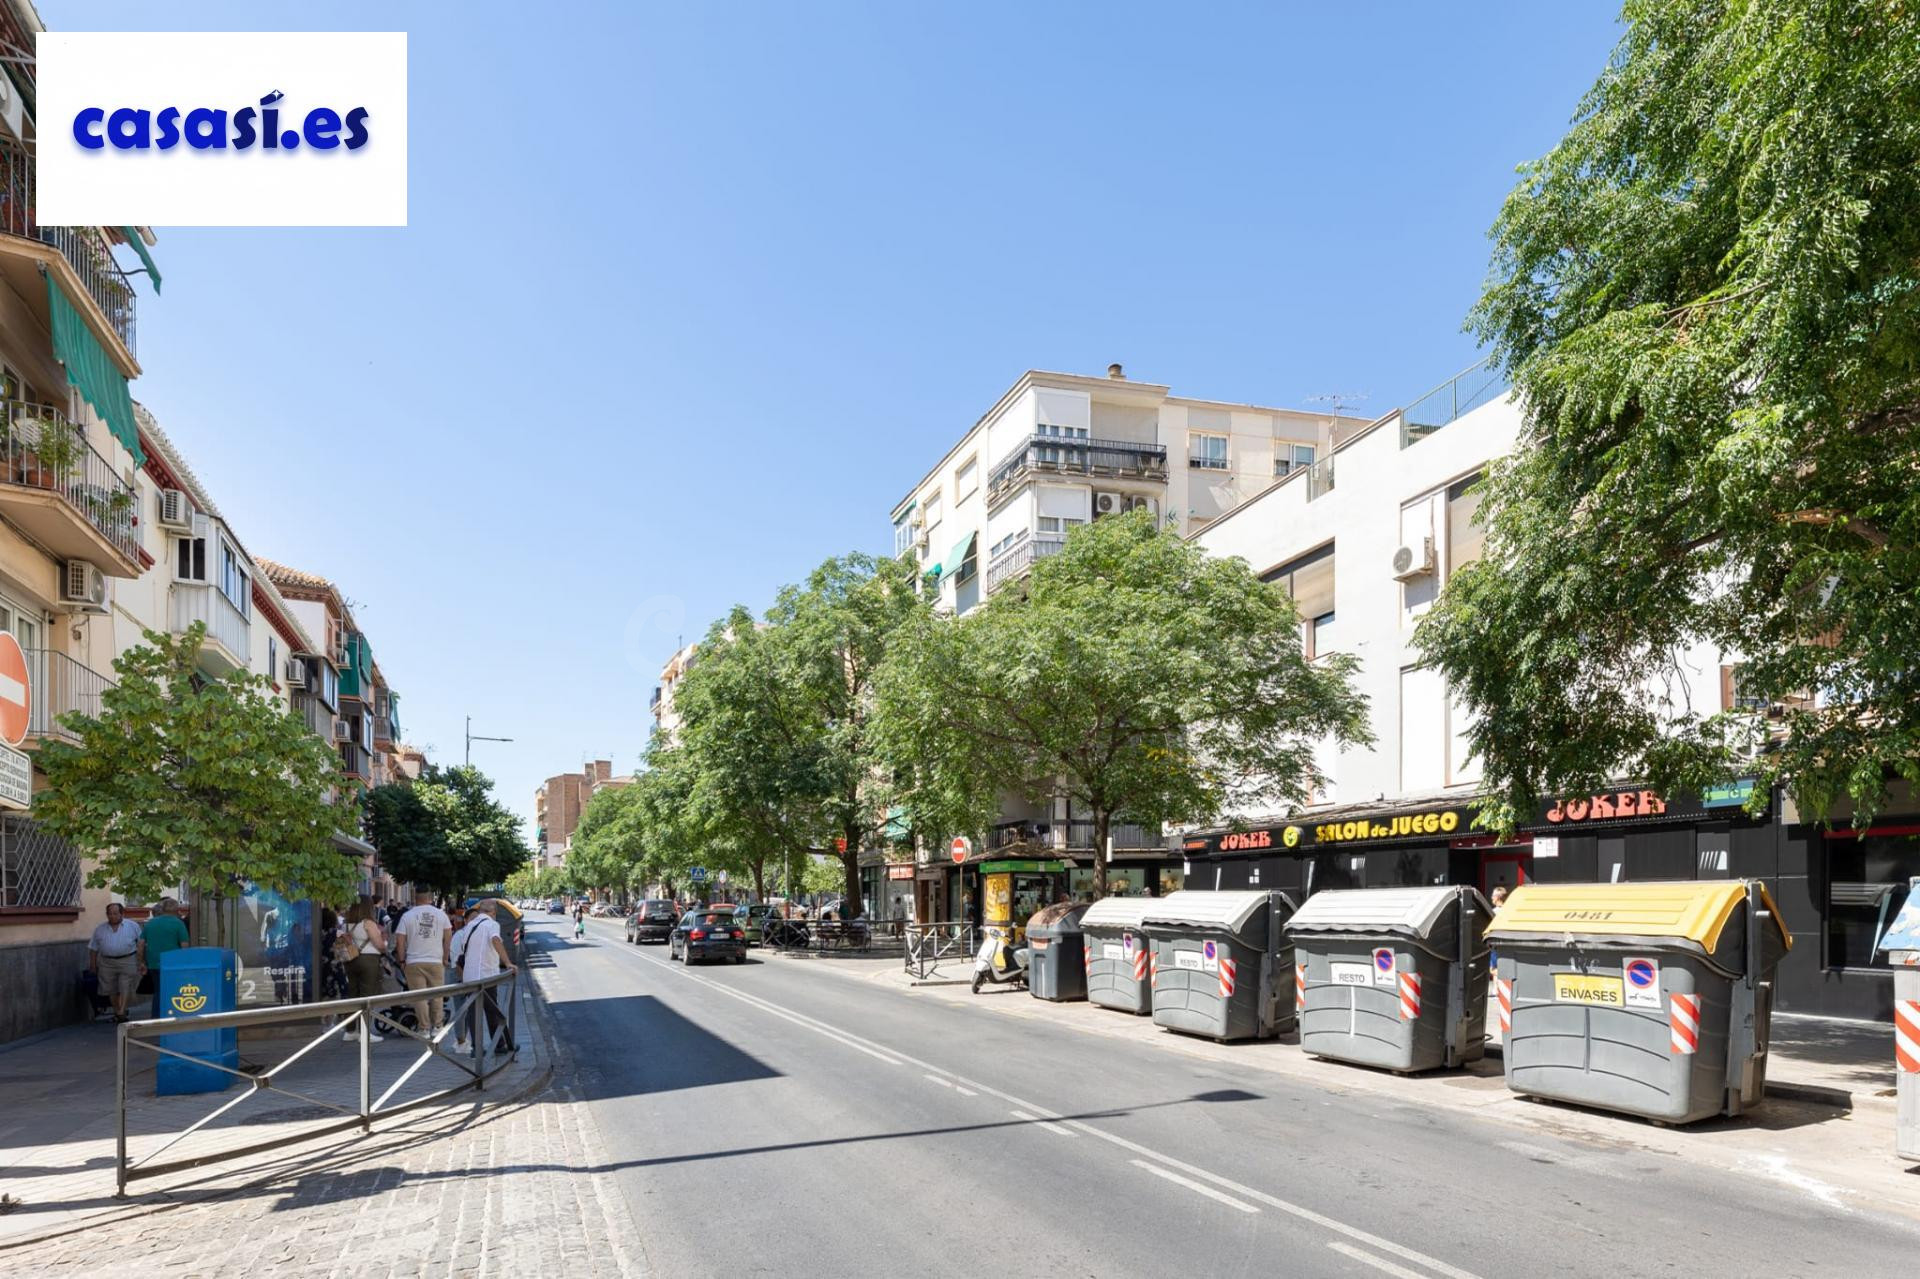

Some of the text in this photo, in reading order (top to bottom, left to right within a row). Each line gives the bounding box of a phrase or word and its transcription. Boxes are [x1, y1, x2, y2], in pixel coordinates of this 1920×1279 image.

[1547, 790, 1666, 822] JOKER
[1370, 824, 1389, 838] de
[1389, 811, 1459, 836] JUEGO
[1220, 831, 1271, 850] JOKER
[263, 965, 306, 977] Respira
[1339, 973, 1365, 983] RESTO
[1560, 987, 1618, 1002] ENVASES
